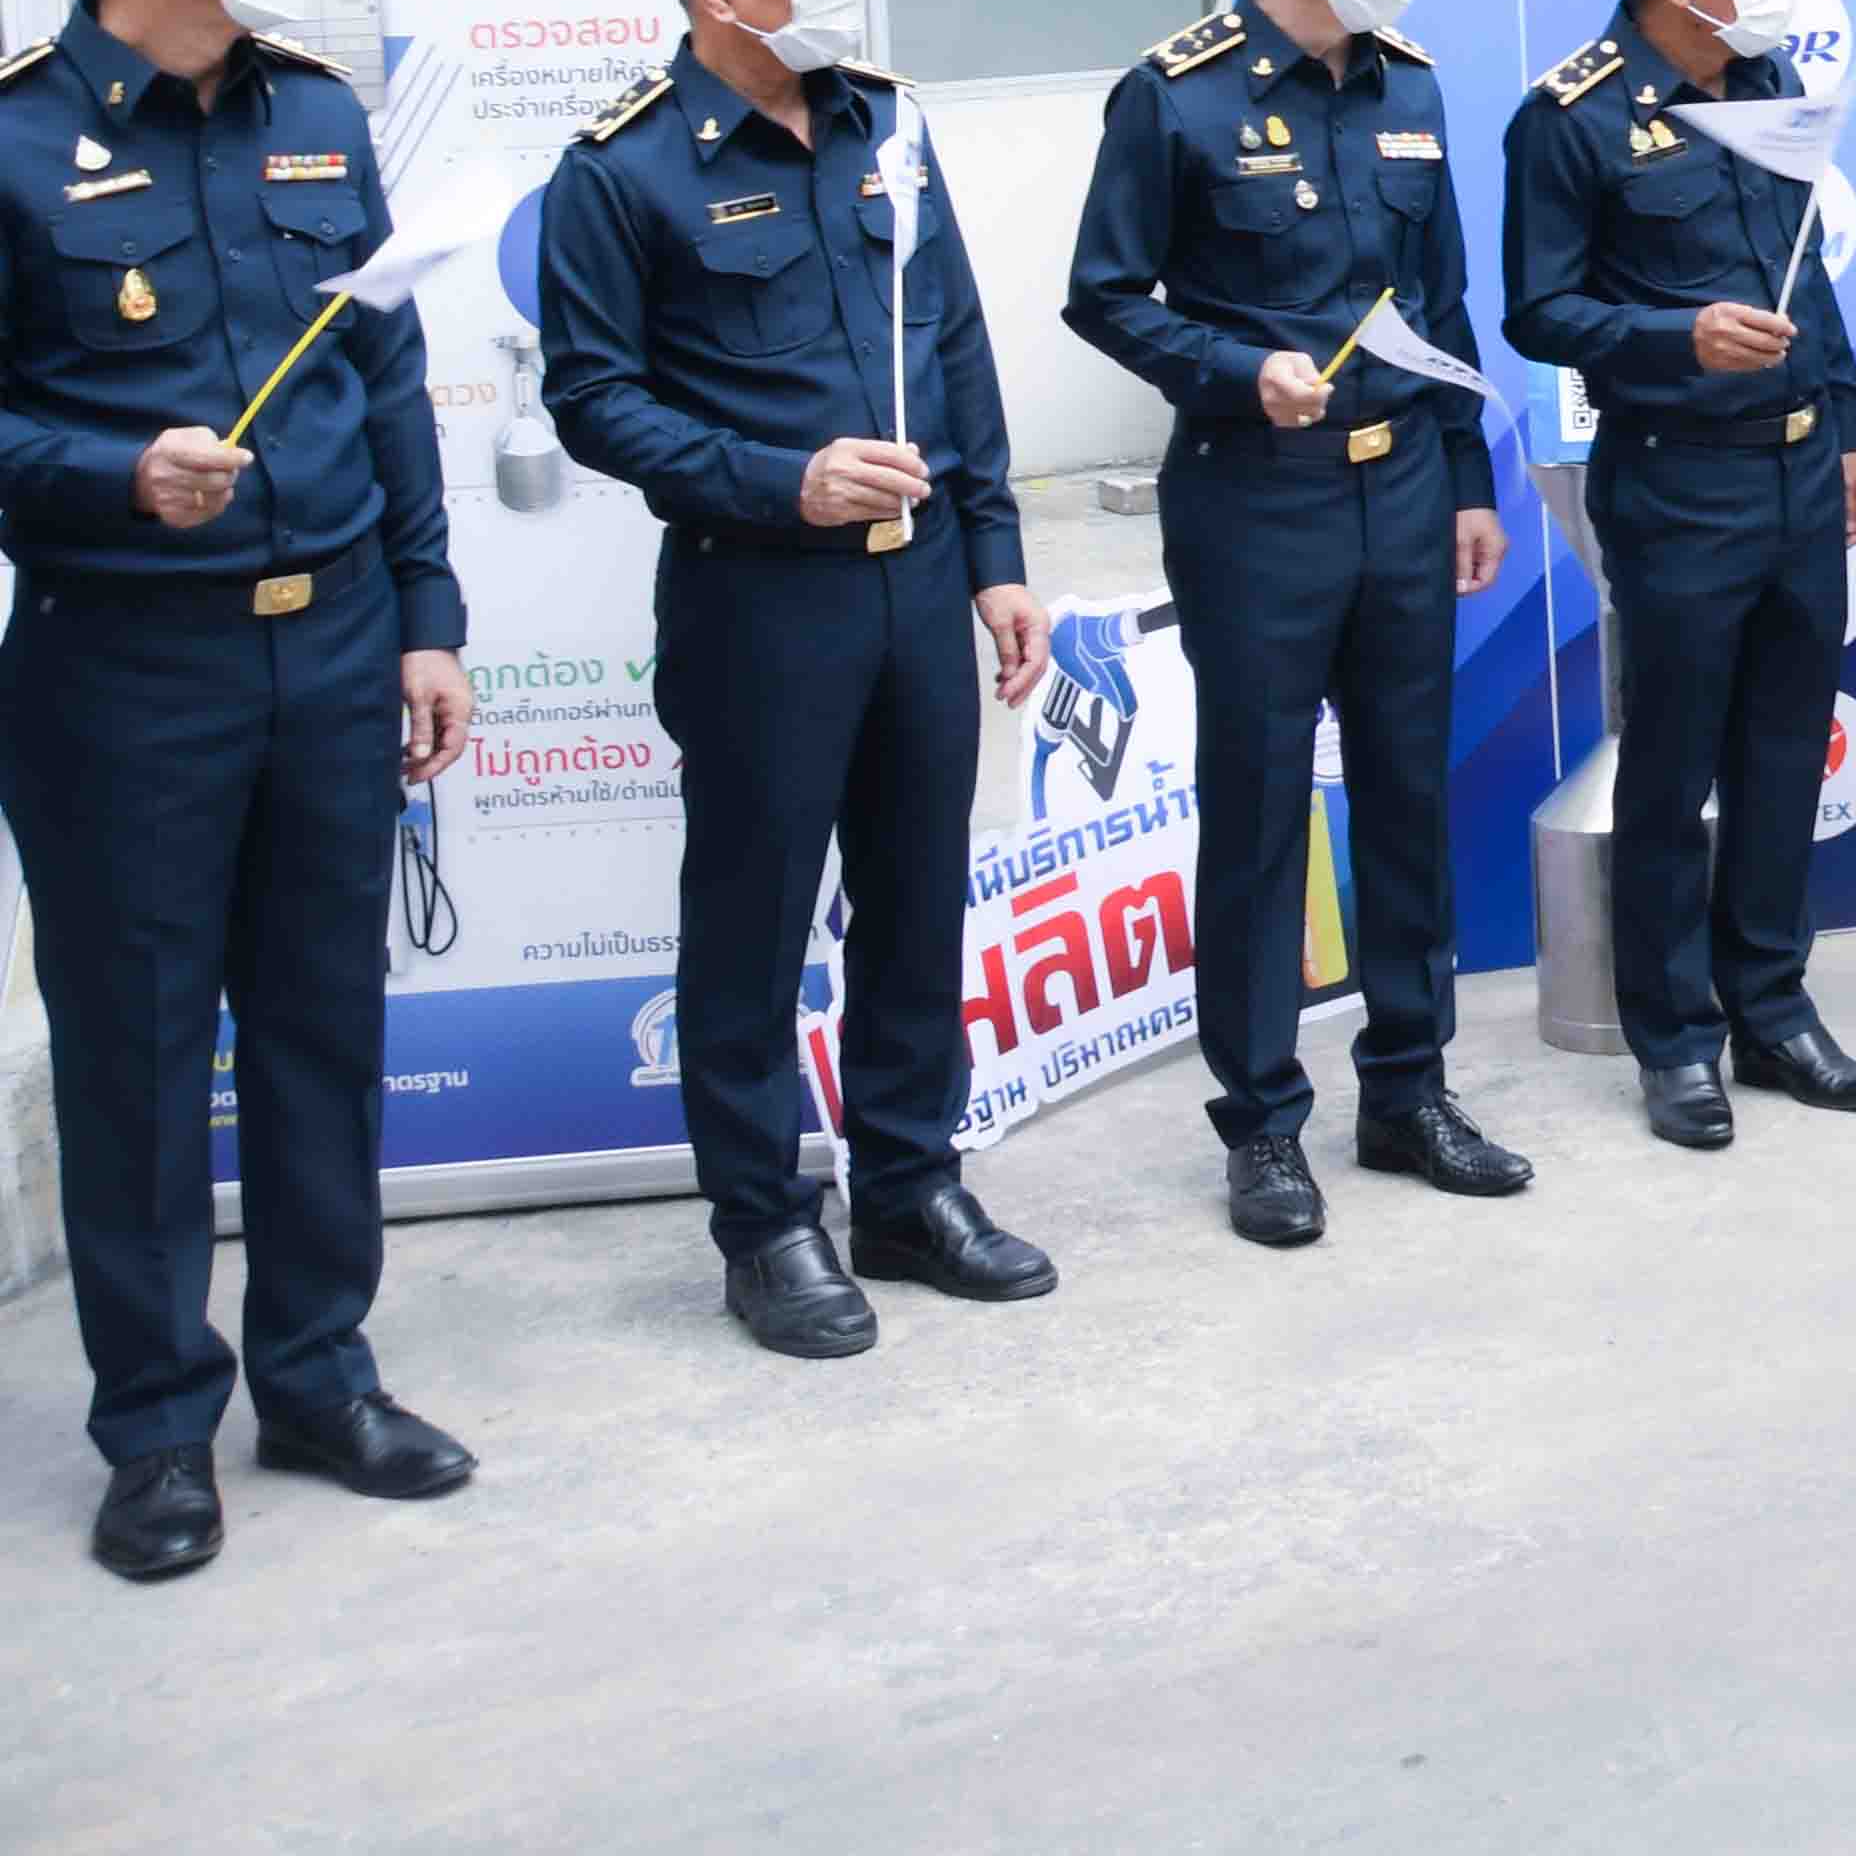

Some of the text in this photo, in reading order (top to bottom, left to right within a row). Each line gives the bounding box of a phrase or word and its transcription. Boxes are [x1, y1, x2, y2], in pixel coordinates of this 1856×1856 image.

[470, 16, 662, 50] ตรวจสอบ
[469, 651, 604, 703] ถูกต้อง
[469, 734, 652, 785] ไม่ถูกต้อง
[1821, 801, 1853, 823] EX
[1040, 992, 1198, 1089] ปริมาณคร
[383, 1067, 470, 1094] าตรฐาน
